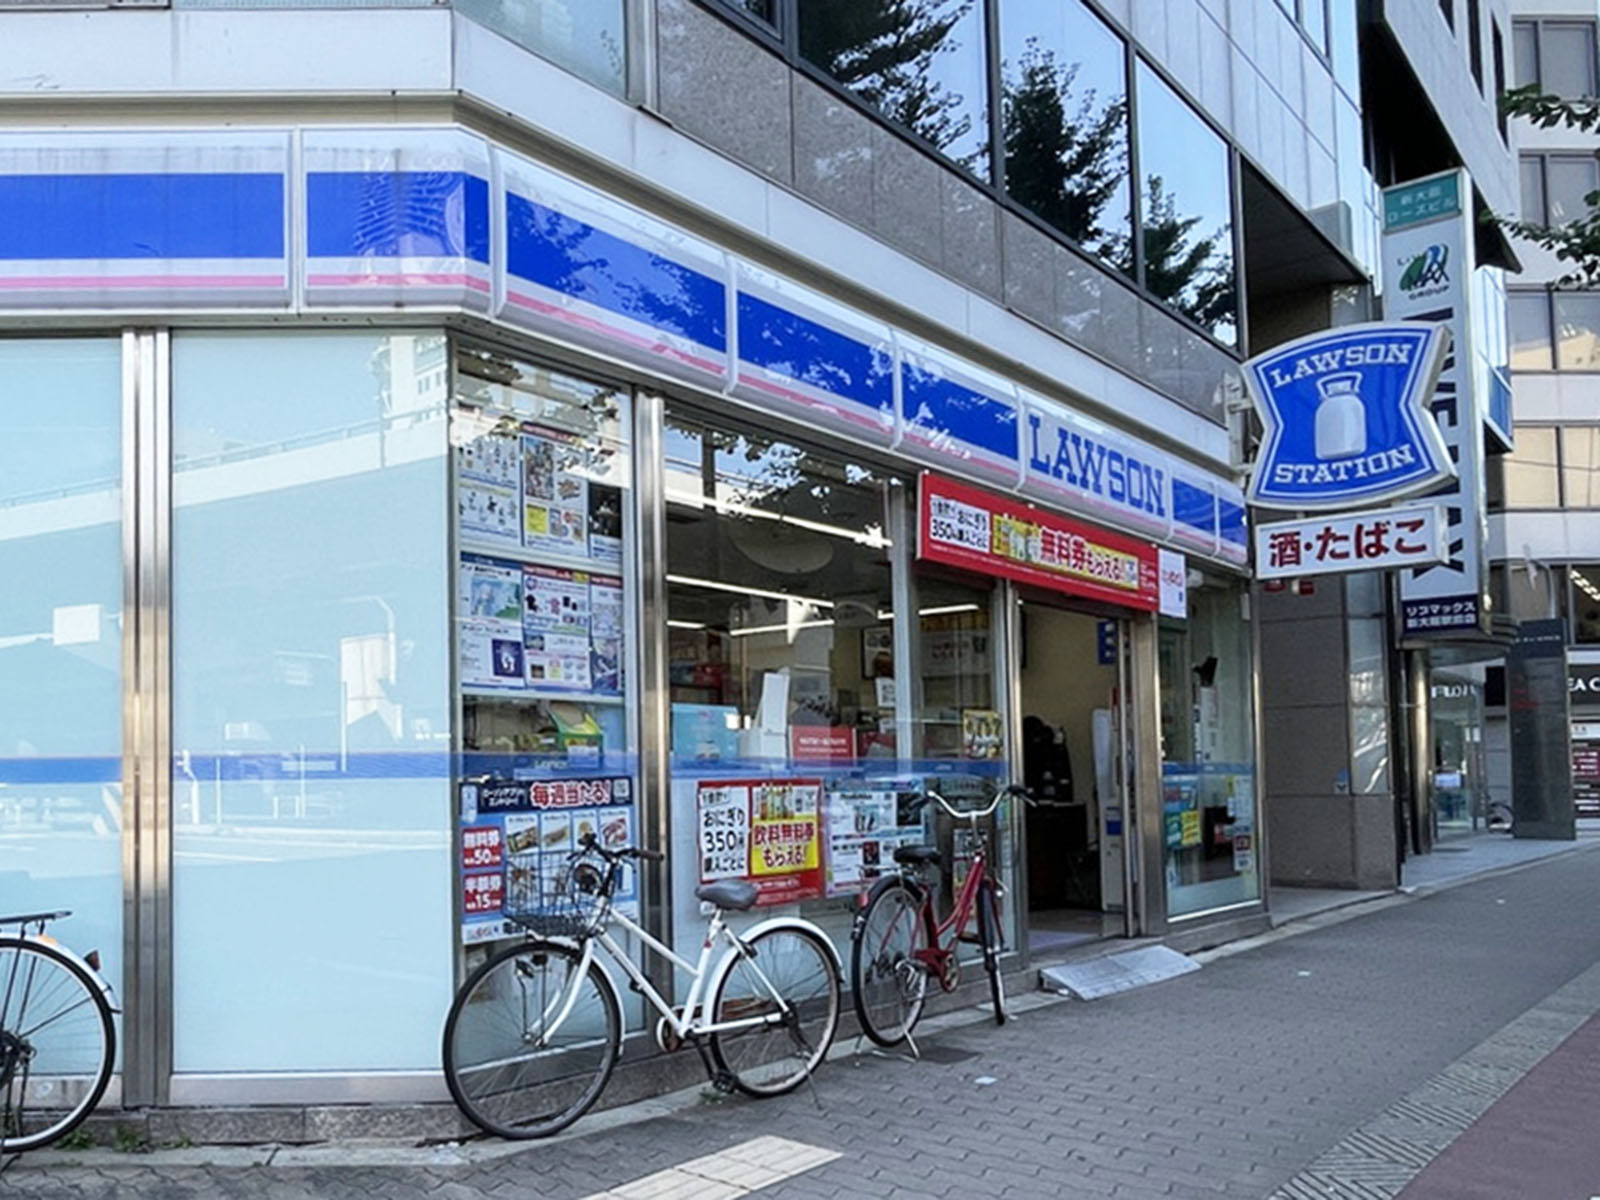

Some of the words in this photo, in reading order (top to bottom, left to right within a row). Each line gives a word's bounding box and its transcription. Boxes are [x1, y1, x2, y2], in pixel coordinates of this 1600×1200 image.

[1270, 343, 1412, 388] LAWSON
[1029, 414, 1165, 517] LAWSON
[1274, 444, 1416, 484] STATION
[1269, 519, 1428, 567] 酒・たばこ
[704, 807, 745, 828] おにぎり
